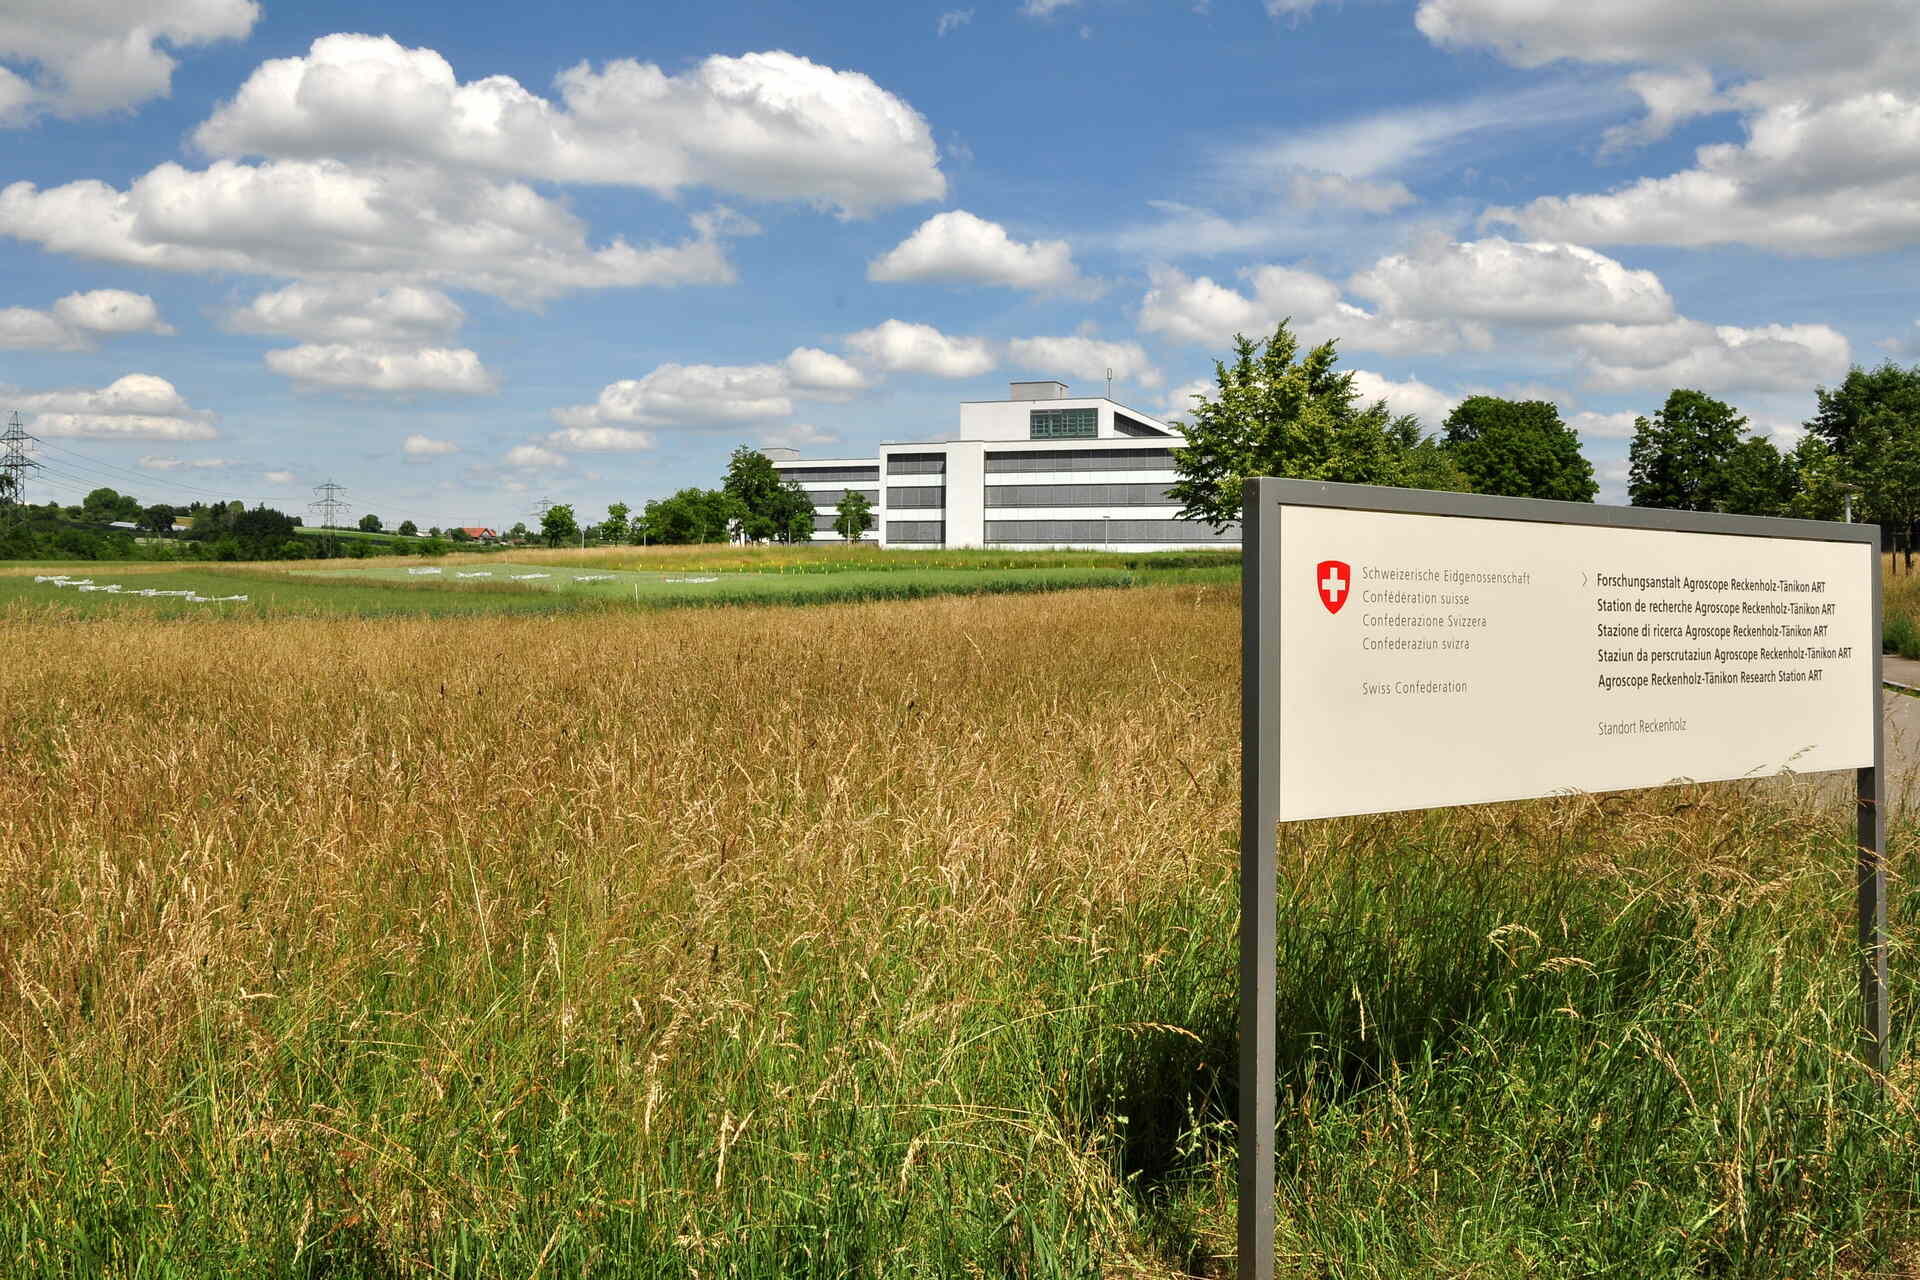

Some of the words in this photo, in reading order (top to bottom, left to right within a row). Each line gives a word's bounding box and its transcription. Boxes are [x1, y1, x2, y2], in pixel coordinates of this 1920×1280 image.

[1362, 566, 1440, 581] Schweizerische
[1444, 569, 1530, 585] Eidgenossenschaft
[1597, 573, 1680, 591] Forschungsanstalt
[1683, 576, 1728, 592] Agroscope
[1731, 578, 1809, 592] Reckenholz-Tänikon
[1811, 582, 1825, 592] ART
[1363, 590, 1437, 603] Confédération
[1441, 594, 1469, 604] suisse
[1597, 599, 1631, 612] Station
[1635, 600, 1646, 612] de
[1649, 600, 1692, 613] recherche
[1695, 601, 1740, 616] Agroscope
[1742, 602, 1820, 615] Reckenholz-Tänikon
[1821, 604, 1835, 615] ART
[1363, 614, 1443, 627] Confederazione
[1448, 615, 1486, 627] Svizzera
[1597, 624, 1638, 637] Stazione
[1641, 624, 1650, 637] di
[1653, 625, 1682, 637] ricerca
[1686, 625, 1731, 640] Agroscope
[1733, 625, 1811, 637] Reckenholz-Tänikon
[1813, 625, 1828, 637] ART
[1363, 637, 1438, 650] Confederaziun
[1442, 638, 1469, 649] svizra
[1598, 649, 1634, 662] Staziun
[1637, 649, 1648, 661] da
[1651, 649, 1711, 663] perscrutaziun
[1714, 649, 1758, 663] Agroscope
[1760, 647, 1836, 659] Reckenholz-Tänikon
[1838, 647, 1851, 658] ART
[1363, 682, 1390, 695] Swiss
[1395, 680, 1467, 694] Confederation
[1598, 674, 1648, 691] Agroscope
[1651, 672, 1738, 686] Reckenholz-Tänikon
[1740, 671, 1776, 684] Research
[1778, 670, 1806, 682] Station
[1808, 669, 1822, 681] ART
[1598, 721, 1636, 736] Standort
[1639, 717, 1686, 733] Reckenholz
